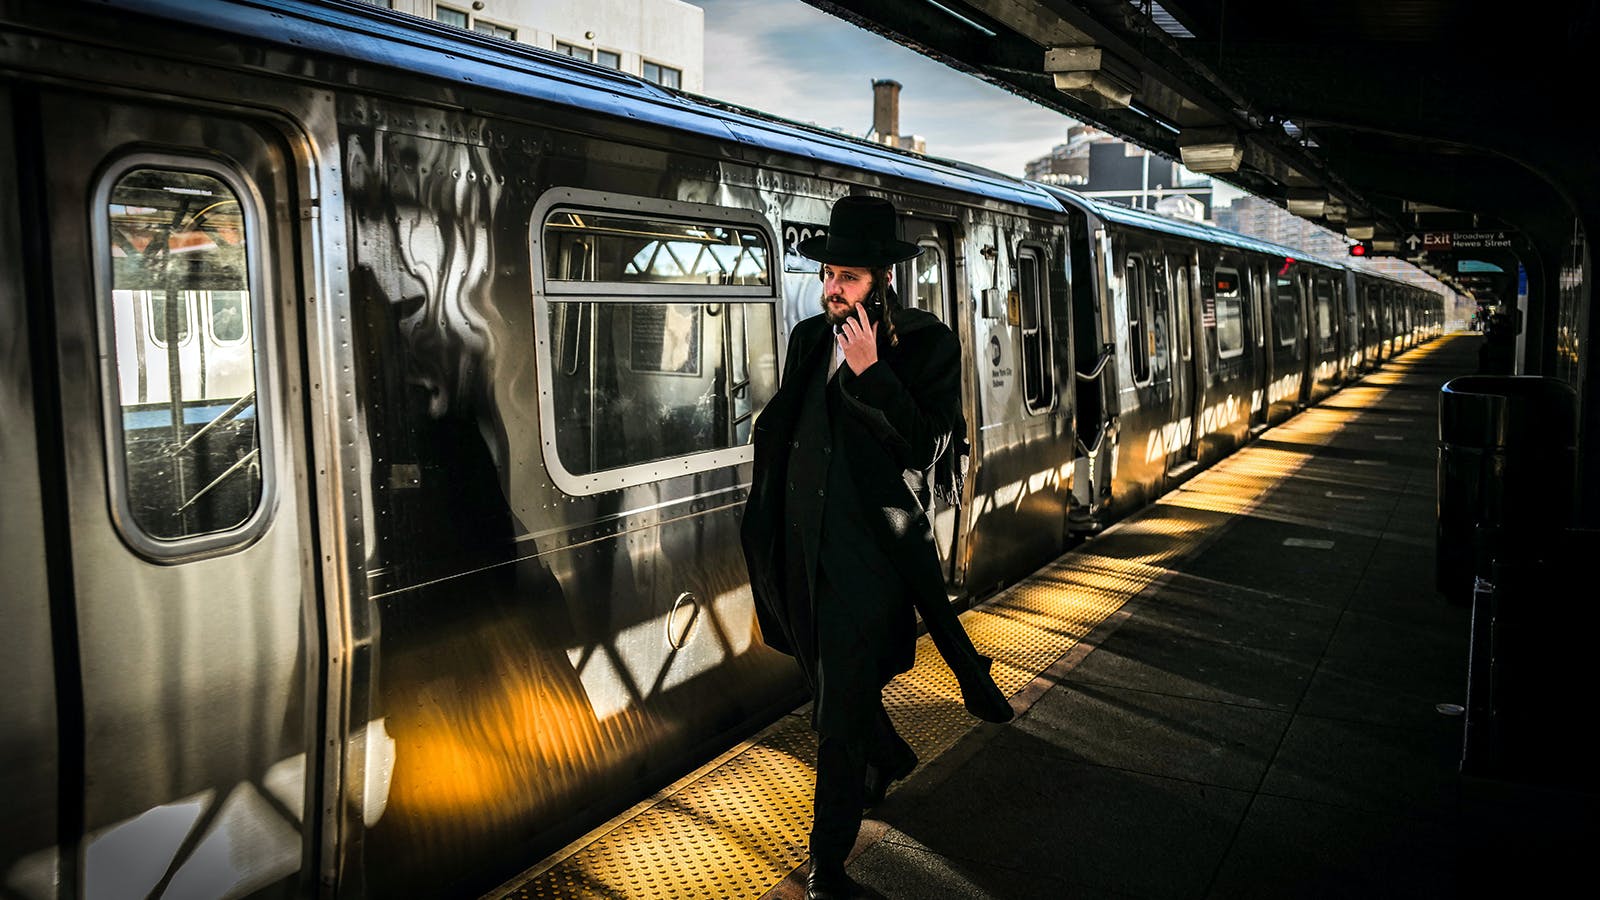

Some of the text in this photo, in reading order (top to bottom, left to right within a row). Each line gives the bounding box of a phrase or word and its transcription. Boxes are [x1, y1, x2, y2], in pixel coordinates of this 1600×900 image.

[1424, 233, 1450, 245] Exit
[1453, 232, 1495, 240] Broadway
[1453, 239, 1512, 248] Hewes Street
